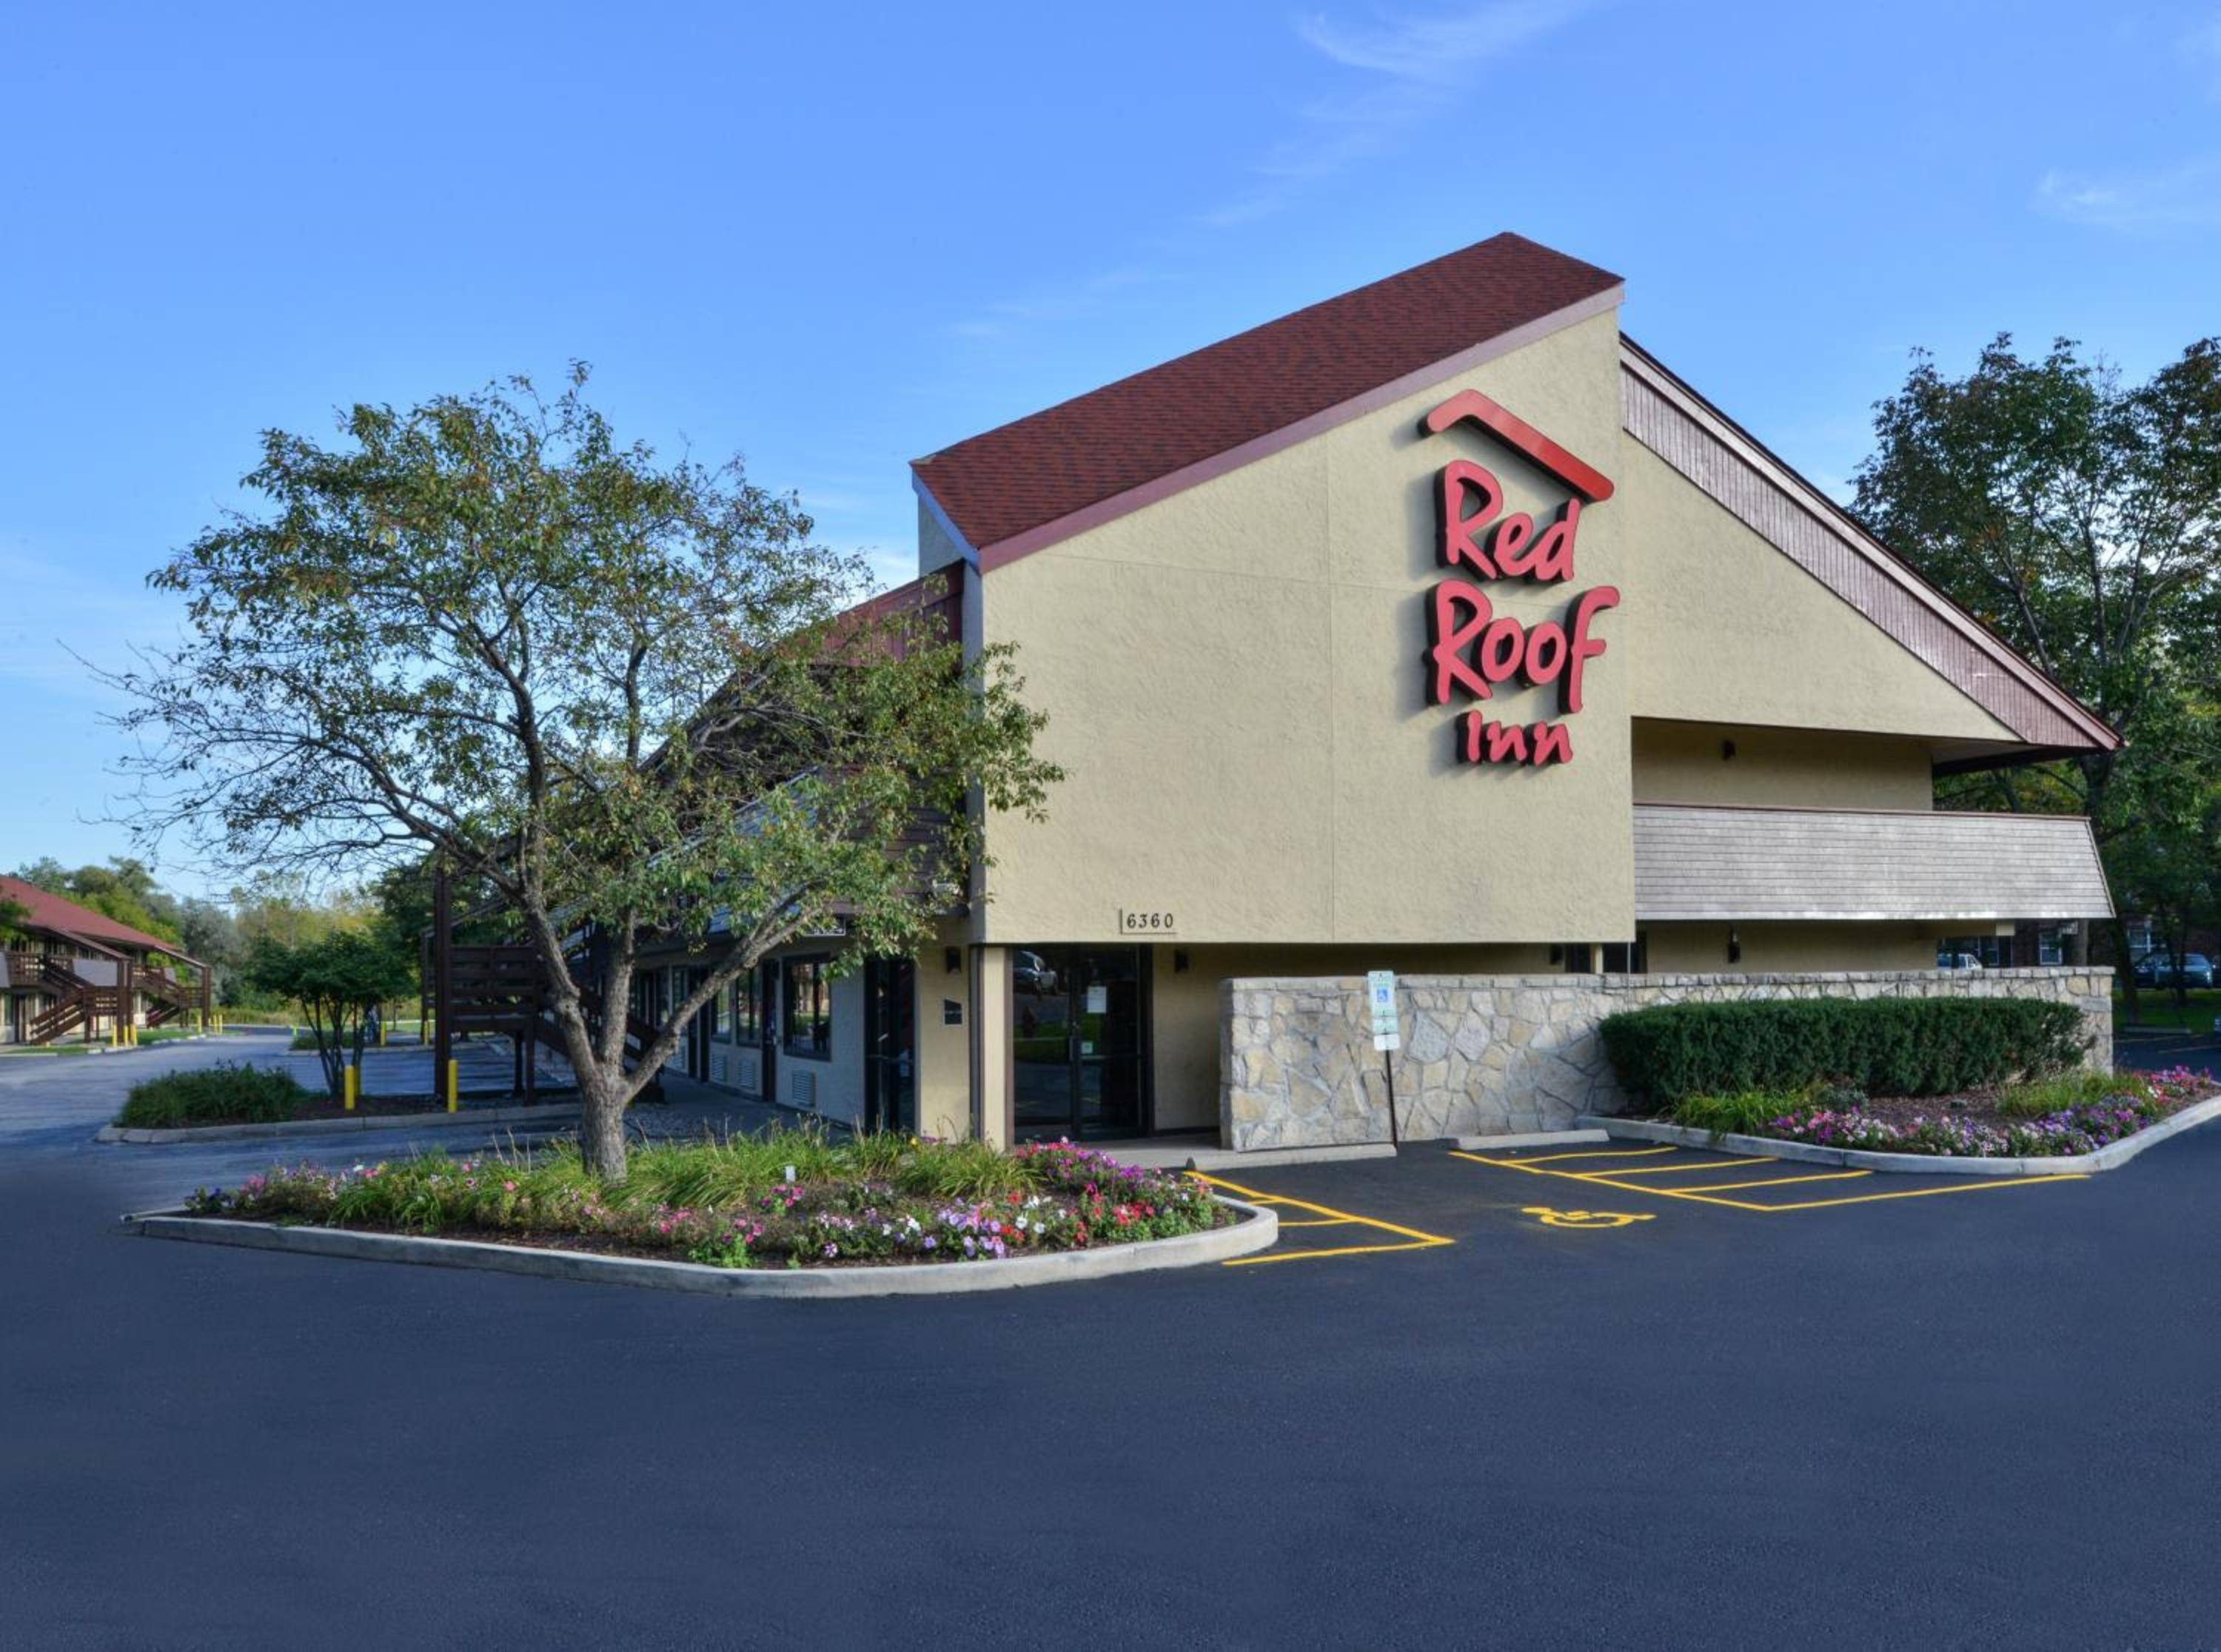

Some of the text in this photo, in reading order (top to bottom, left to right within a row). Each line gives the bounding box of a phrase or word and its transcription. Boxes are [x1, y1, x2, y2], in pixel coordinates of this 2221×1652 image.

[1444, 460, 1581, 581] Red
[1432, 579, 1621, 713] Roof
[1464, 710, 1574, 765] Inn
[1126, 913, 1174, 929] 6360
